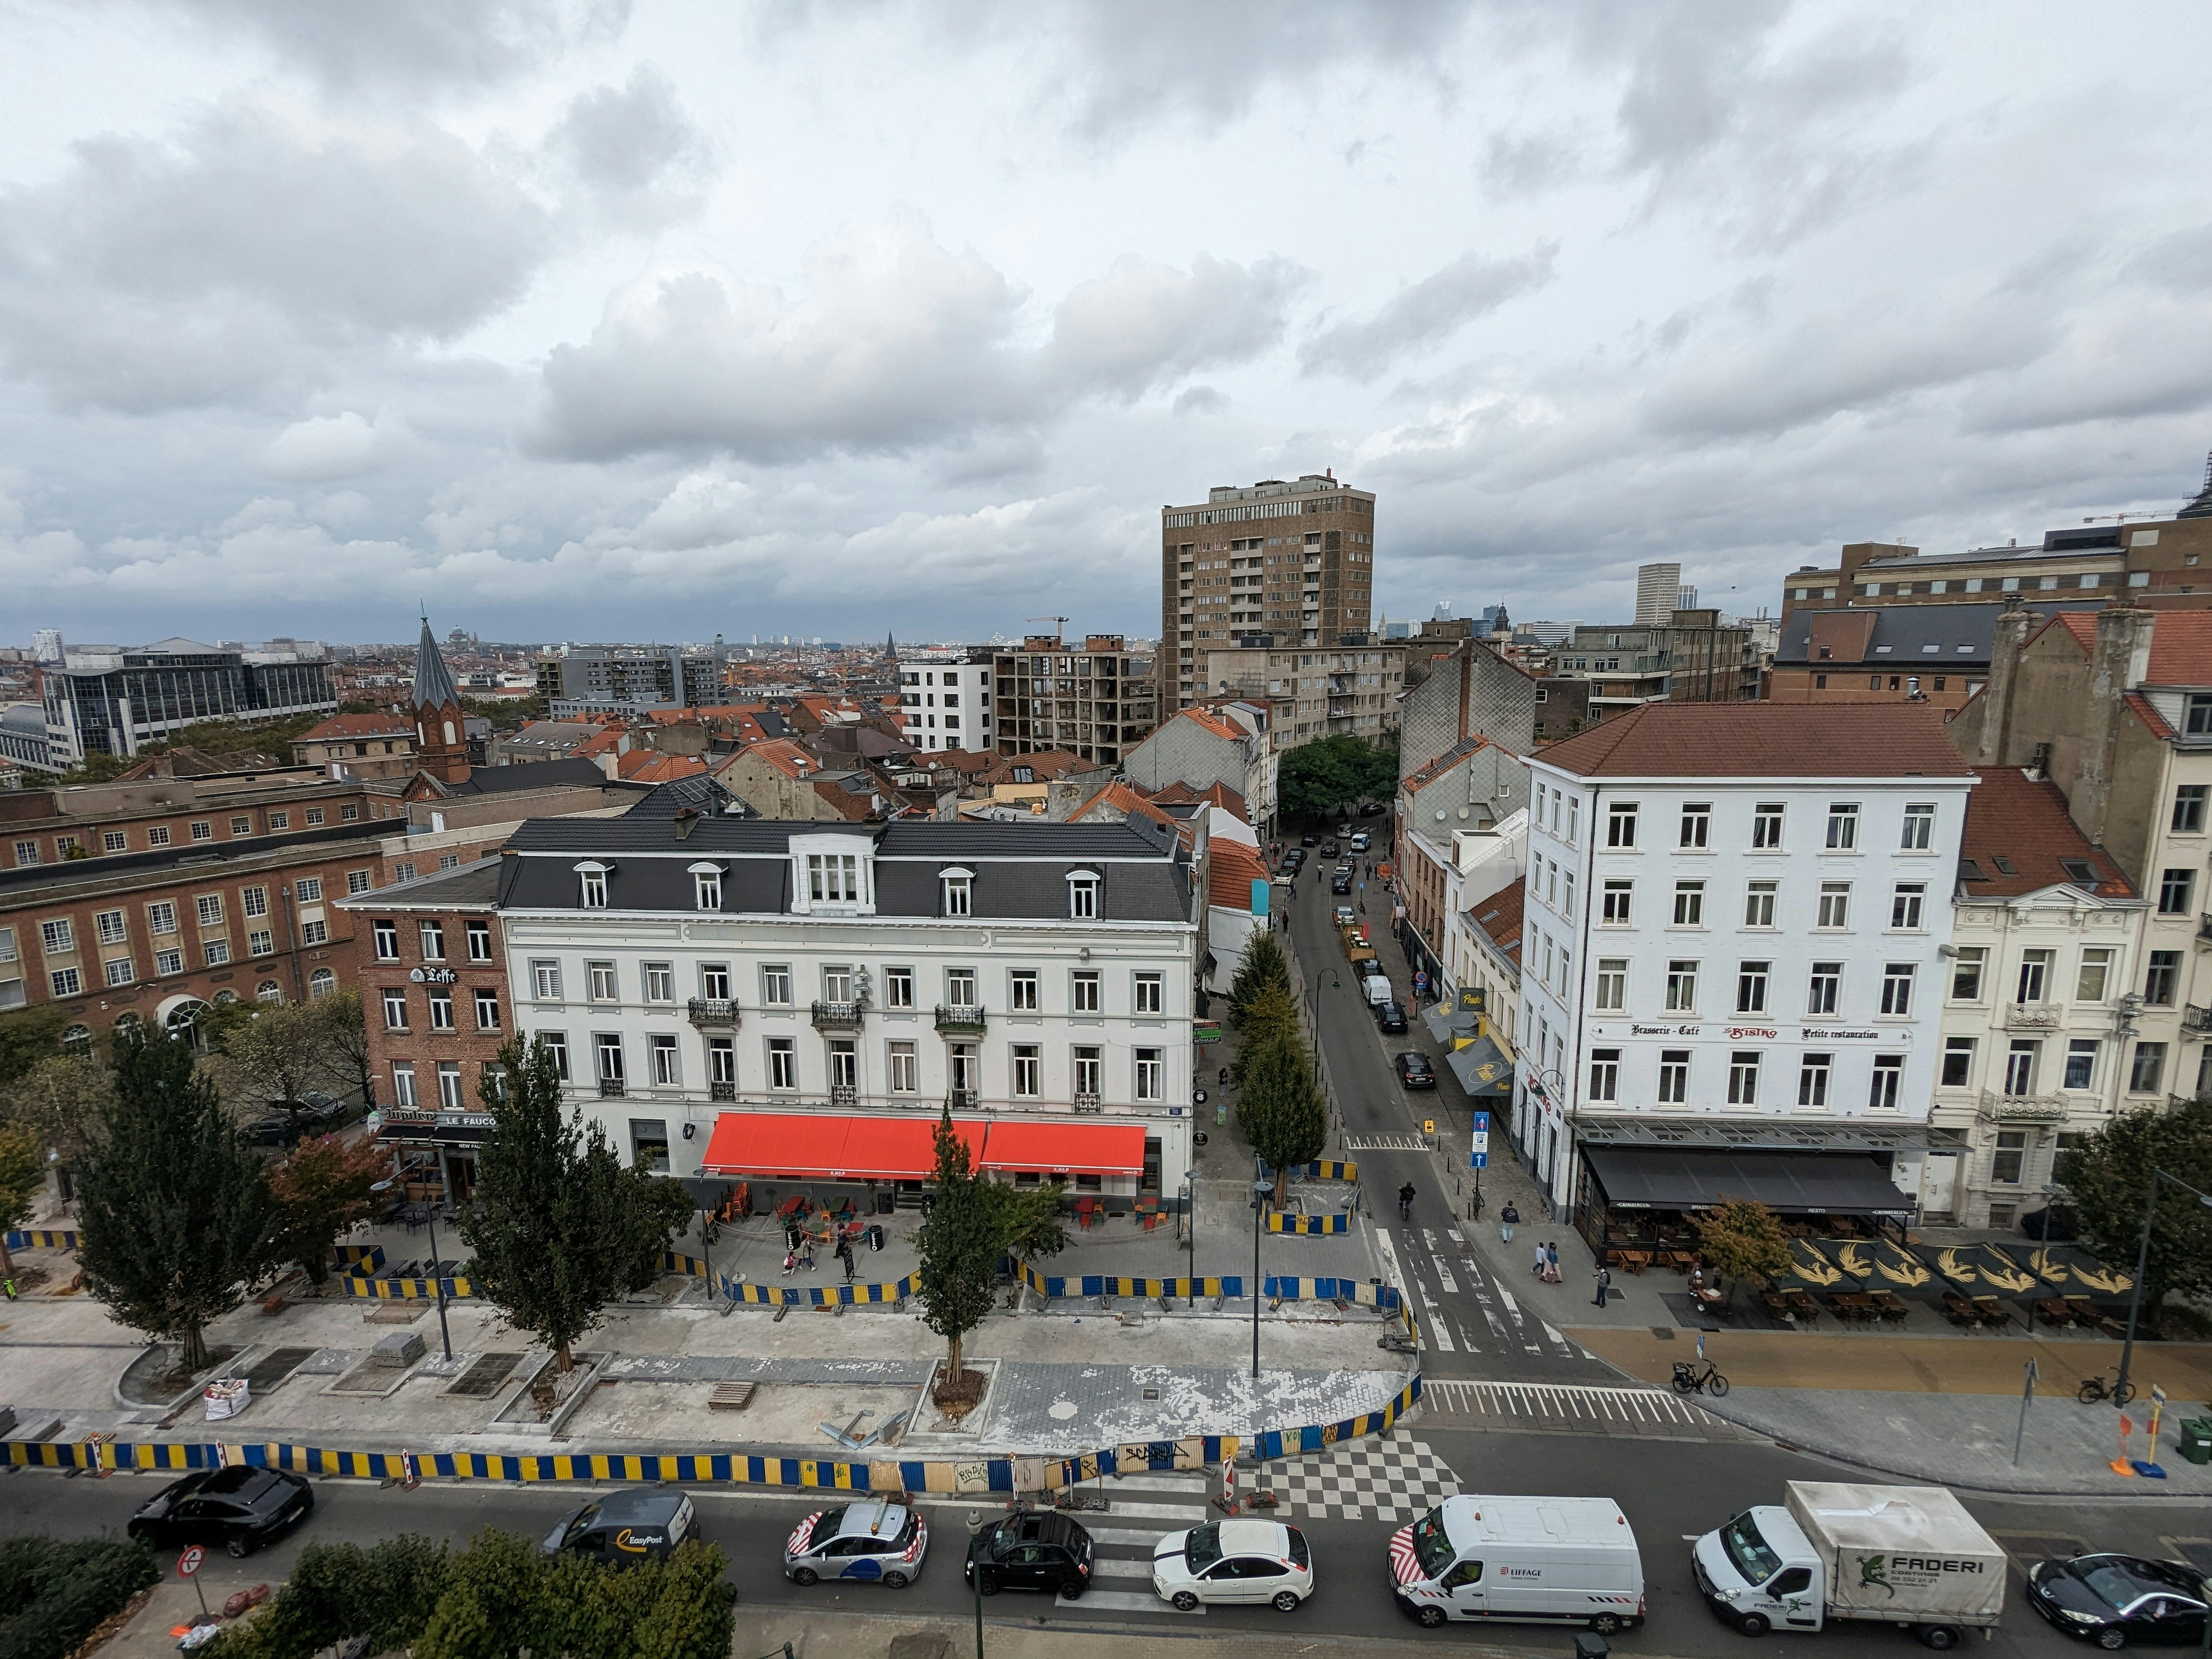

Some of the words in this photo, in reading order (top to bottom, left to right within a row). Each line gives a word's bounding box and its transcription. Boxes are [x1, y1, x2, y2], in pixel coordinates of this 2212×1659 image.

[427, 968, 455, 984] Leffe
[1463, 994, 1481, 1005] Prado
[1631, 1024, 1670, 1036] Brasserie
[1679, 1025, 1700, 1035] Café
[1802, 1028, 1829, 1041] Petite
[1830, 1029, 1878, 1039] restauration
[1497, 1082, 1510, 1091] Prado
[385, 1107, 435, 1123] Jupiler
[629, 1536, 662, 1545] EasyPost
[1892, 1558, 1984, 1573] FADERI
